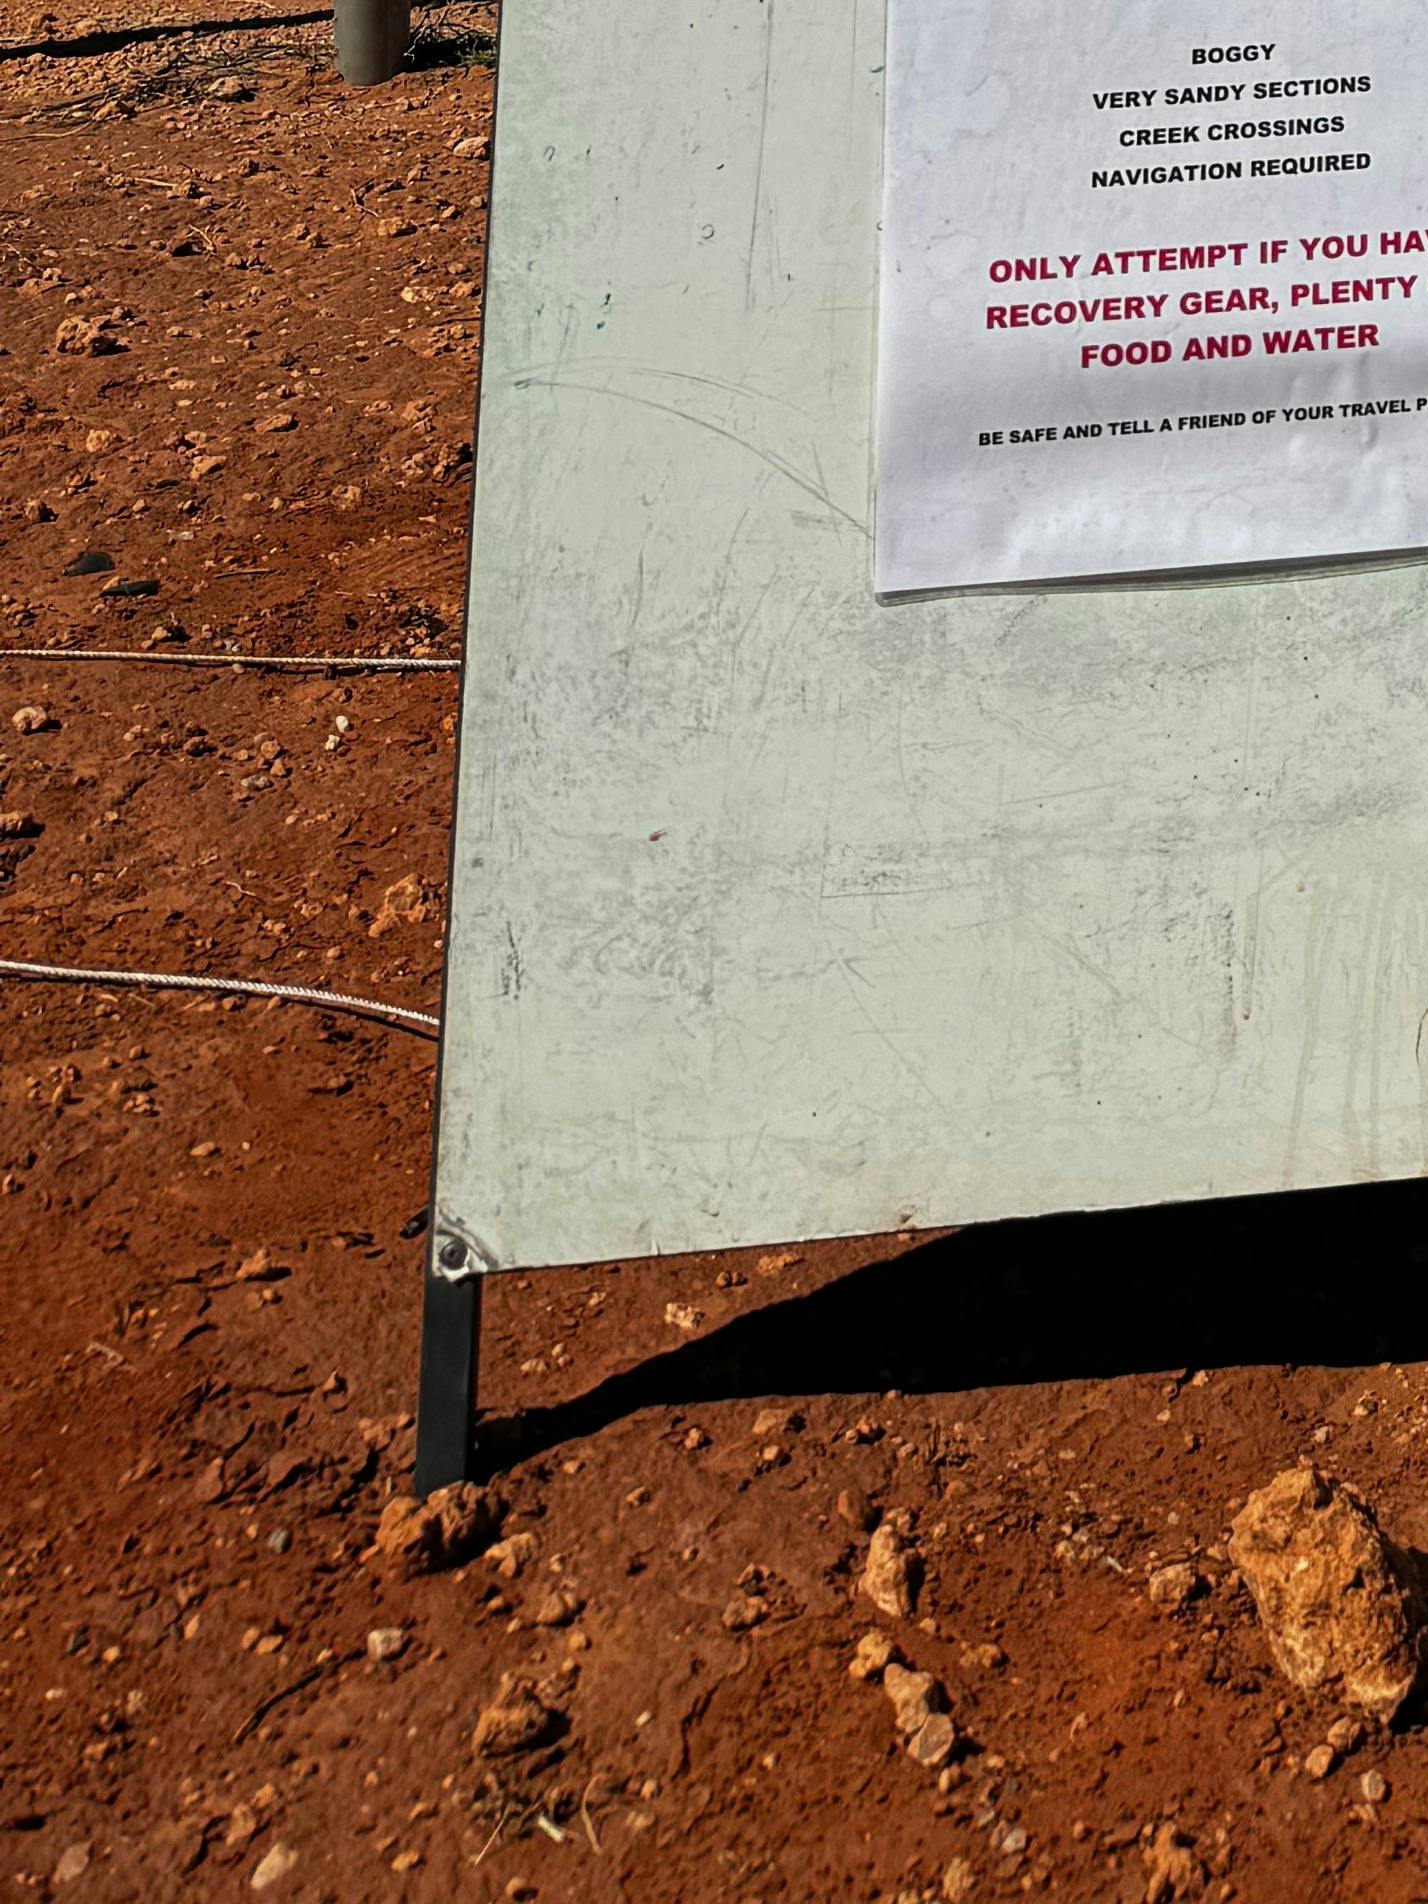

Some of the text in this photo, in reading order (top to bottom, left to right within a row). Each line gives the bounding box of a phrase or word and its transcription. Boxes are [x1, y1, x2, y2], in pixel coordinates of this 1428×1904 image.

[1192, 44, 1275, 64] BOGGY
[1093, 76, 1371, 109] VERY SANDY SECTIONS
[1120, 116, 1344, 146] CREEK CROSSINGS
[1092, 153, 1370, 188] NAVIGATION REQUIRED
[990, 255, 1080, 283] ONLY
[1091, 243, 1248, 276] ATTEMPT
[1260, 240, 1288, 264] IF
[1299, 234, 1368, 260] YOU
[987, 294, 1168, 329] RECOVERY
[1180, 287, 1278, 315] GEAR,
[1291, 275, 1417, 307] PLENTY
[1082, 324, 1379, 368] FOOD AND WATER
[979, 432, 1003, 446] BE
[1010, 428, 1057, 443] SAFE
[1063, 424, 1102, 439] AND
[1108, 420, 1154, 435] TELL
[1160, 419, 1172, 432] A
[1178, 413, 1246, 430] FRIEND
[1252, 410, 1276, 424] OF
[1282, 406, 1334, 422] YOUR
[1339, 400, 1411, 417] TRAVEL
